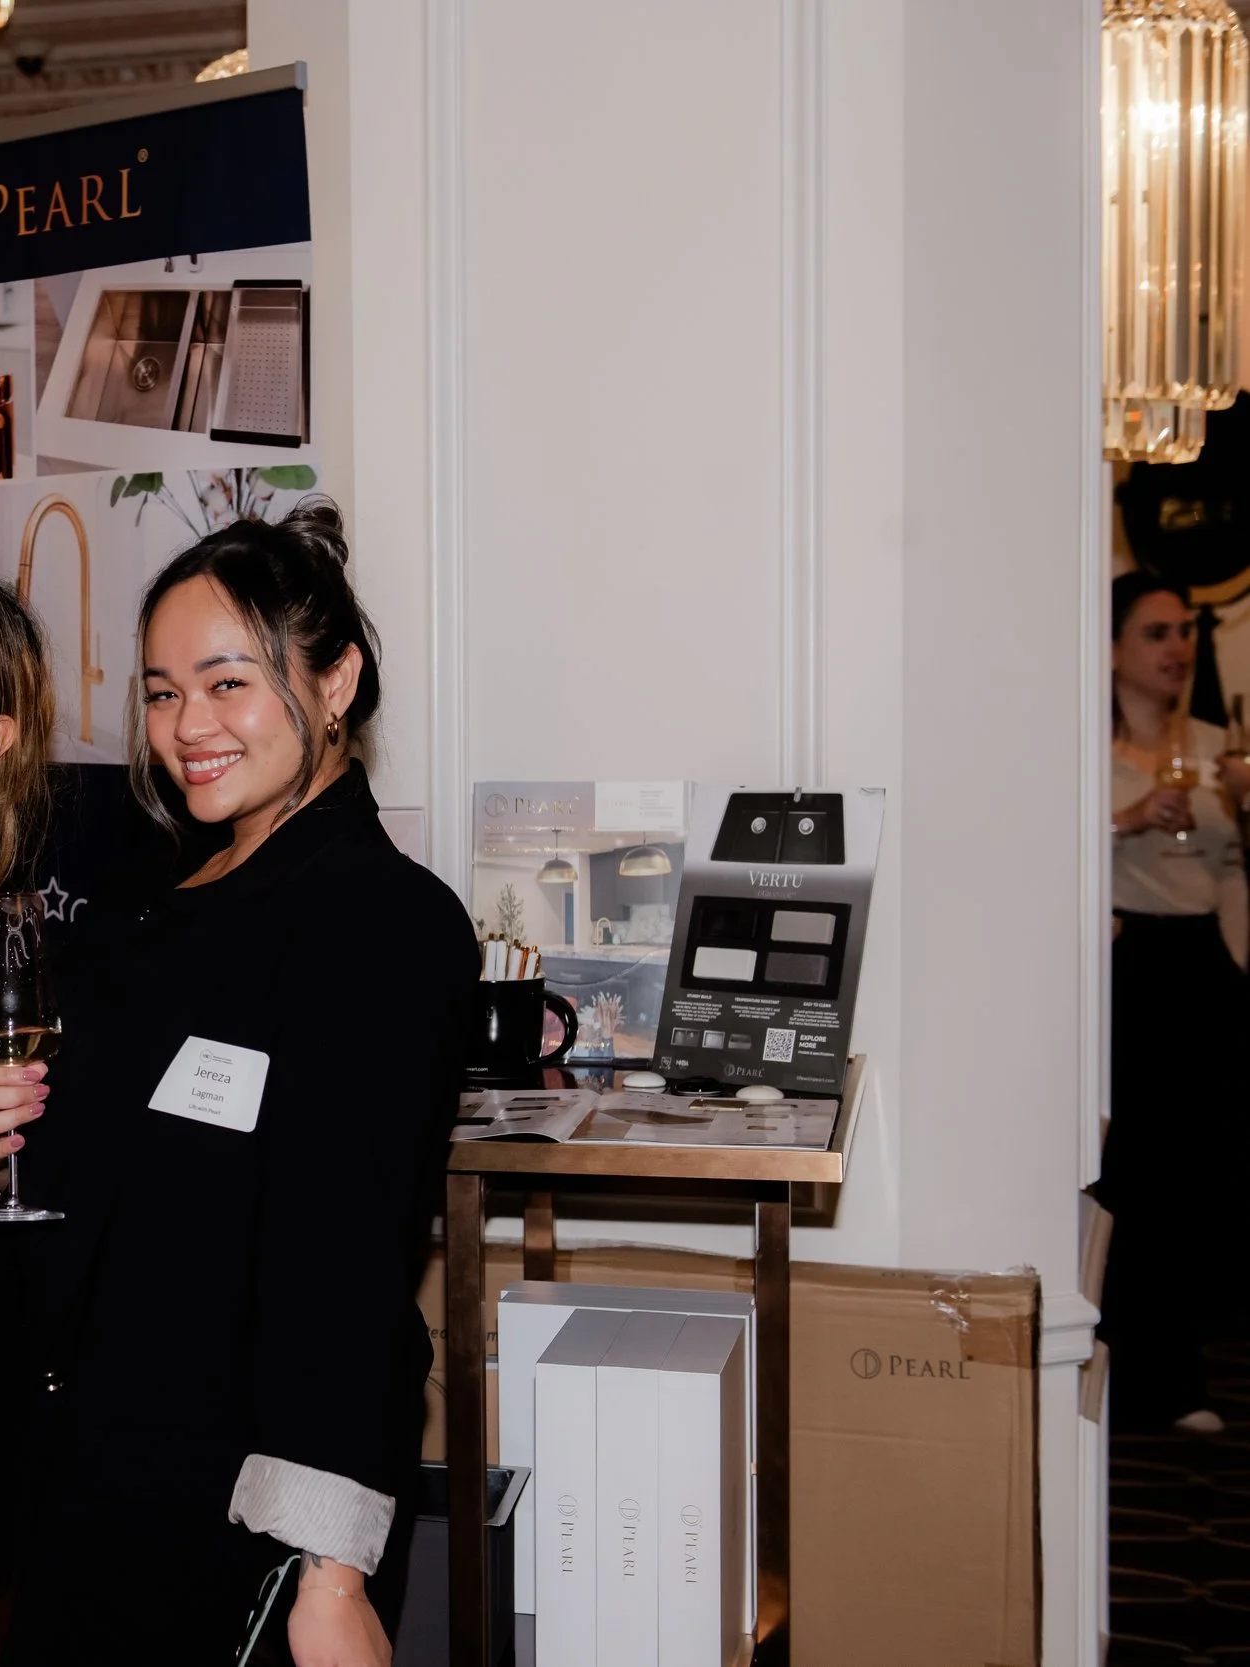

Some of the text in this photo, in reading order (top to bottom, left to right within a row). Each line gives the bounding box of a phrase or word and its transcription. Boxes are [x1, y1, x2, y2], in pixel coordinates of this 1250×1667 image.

[749, 869, 804, 889] VERTU
[800, 1034, 827, 1043] EXPLORE
[193, 1065, 231, 1084] Jereza
[191, 1087, 224, 1102] Lagman
